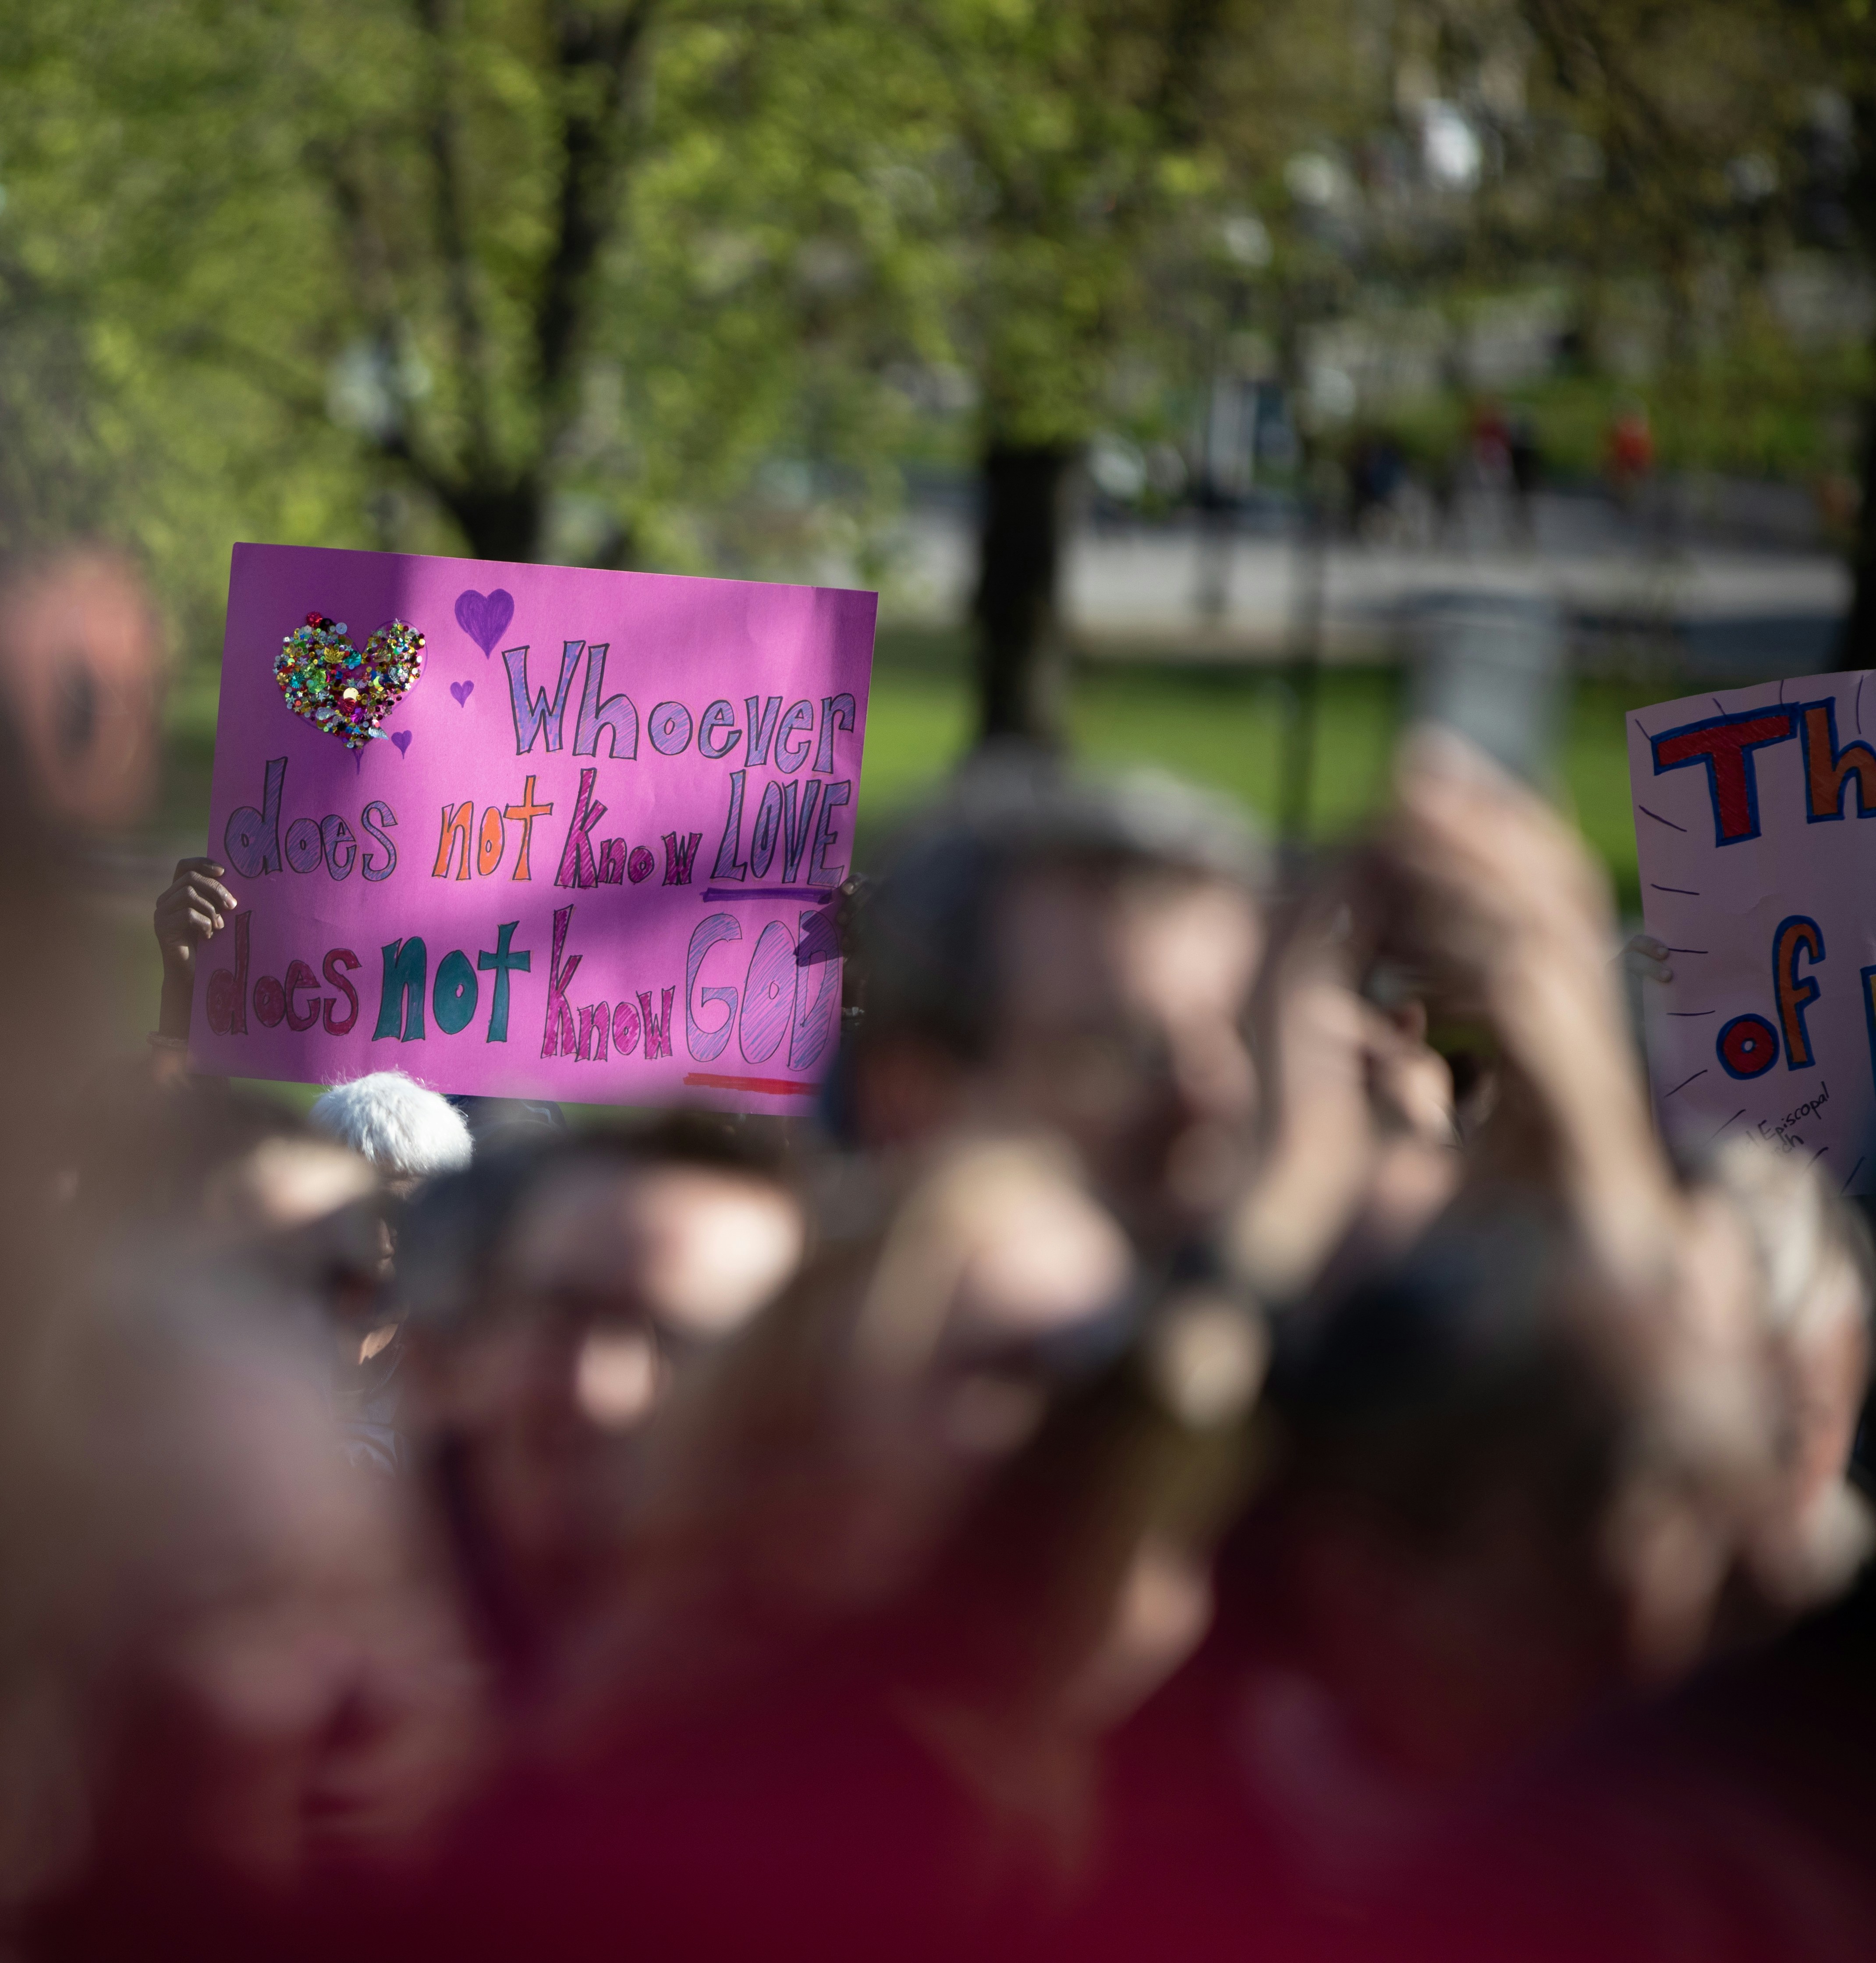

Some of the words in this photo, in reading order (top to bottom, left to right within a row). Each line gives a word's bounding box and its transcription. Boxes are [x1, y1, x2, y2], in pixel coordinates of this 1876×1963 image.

[502, 640, 855, 773] Whoever
[224, 756, 398, 881] does
[432, 774, 554, 881] not
[710, 769, 851, 887] LOVE
[206, 910, 361, 1036] does
[372, 921, 531, 1043] not
[541, 904, 675, 1063] know
[686, 910, 840, 1071] GOD
[1716, 915, 1826, 1081] of
[1758, 1081, 1829, 1143] Episcopal
